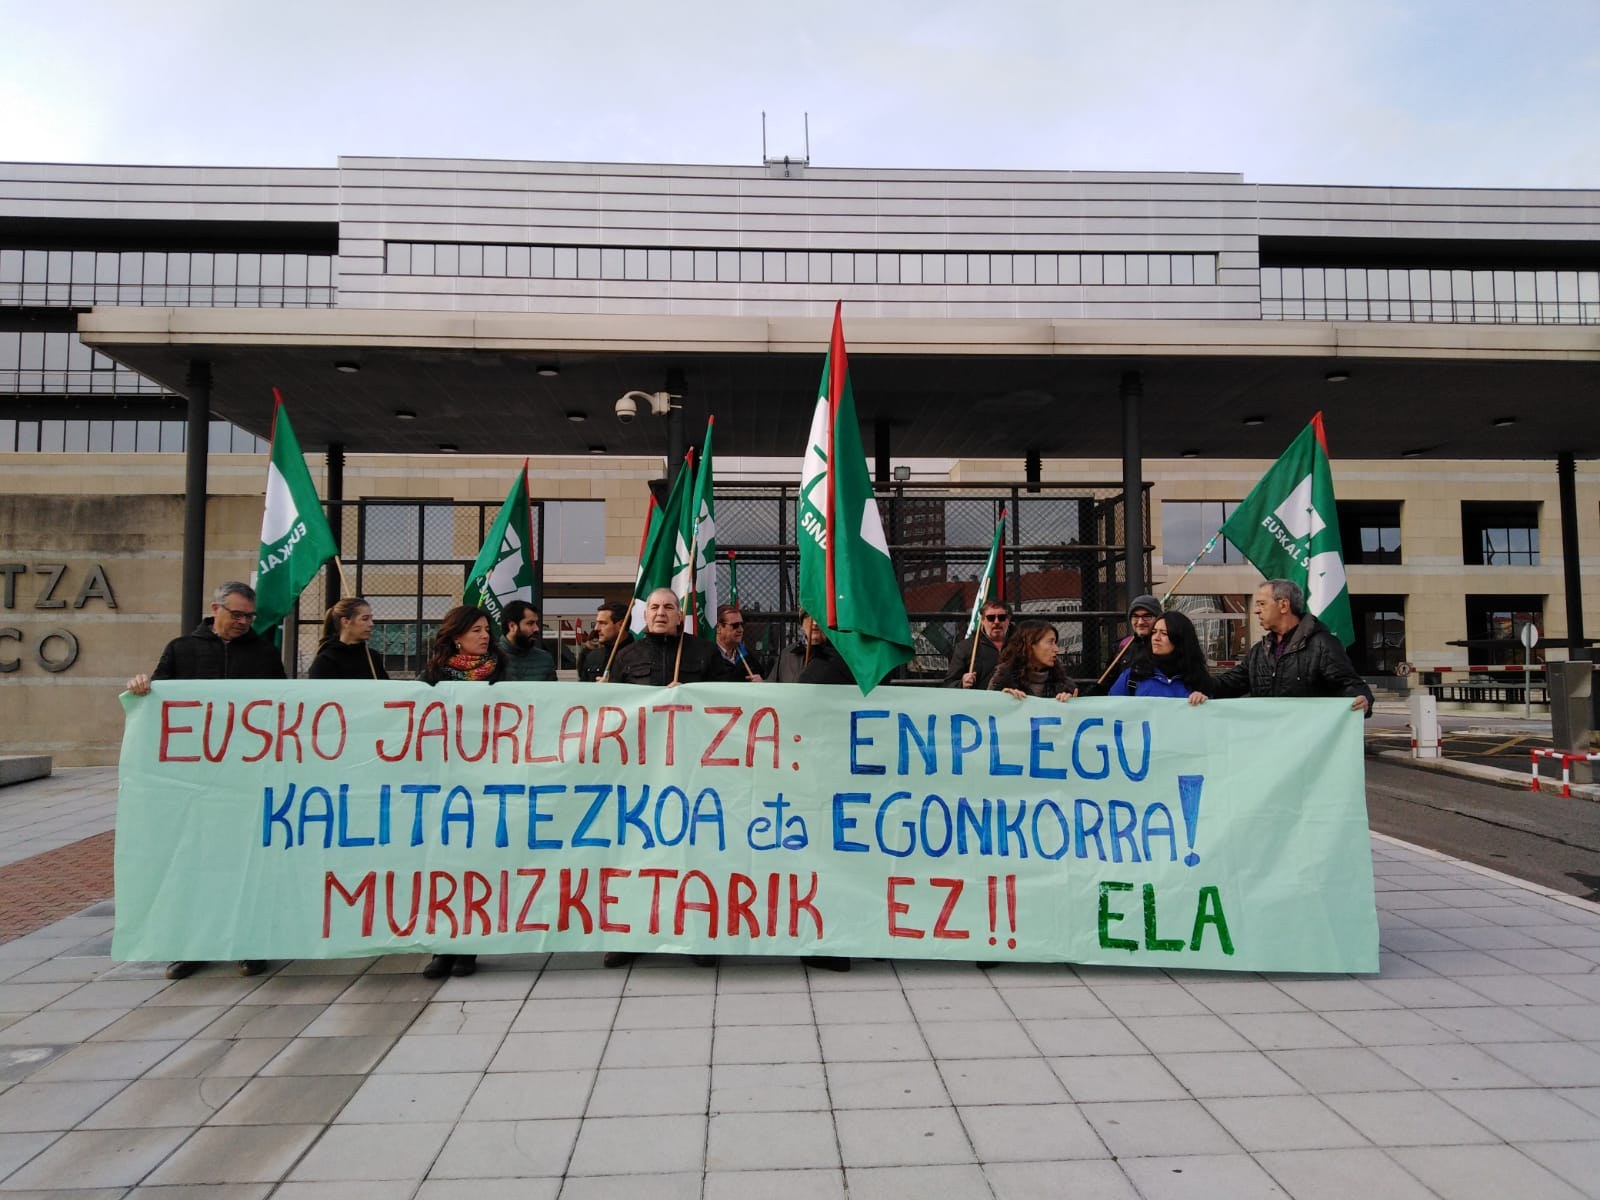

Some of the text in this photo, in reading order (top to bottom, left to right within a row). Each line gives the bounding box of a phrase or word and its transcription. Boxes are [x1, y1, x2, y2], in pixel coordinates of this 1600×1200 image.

[1261, 516, 1302, 560] EUSKAL
[159, 699, 1152, 783] EUSKO JAURLARITZA: ENPLEGU
[262, 774, 1205, 868] KALITATEZKOA eta EGONKORRA!
[322, 867, 824, 941] MURRIZKETARIK
[1097, 880, 1236, 956] ELA
